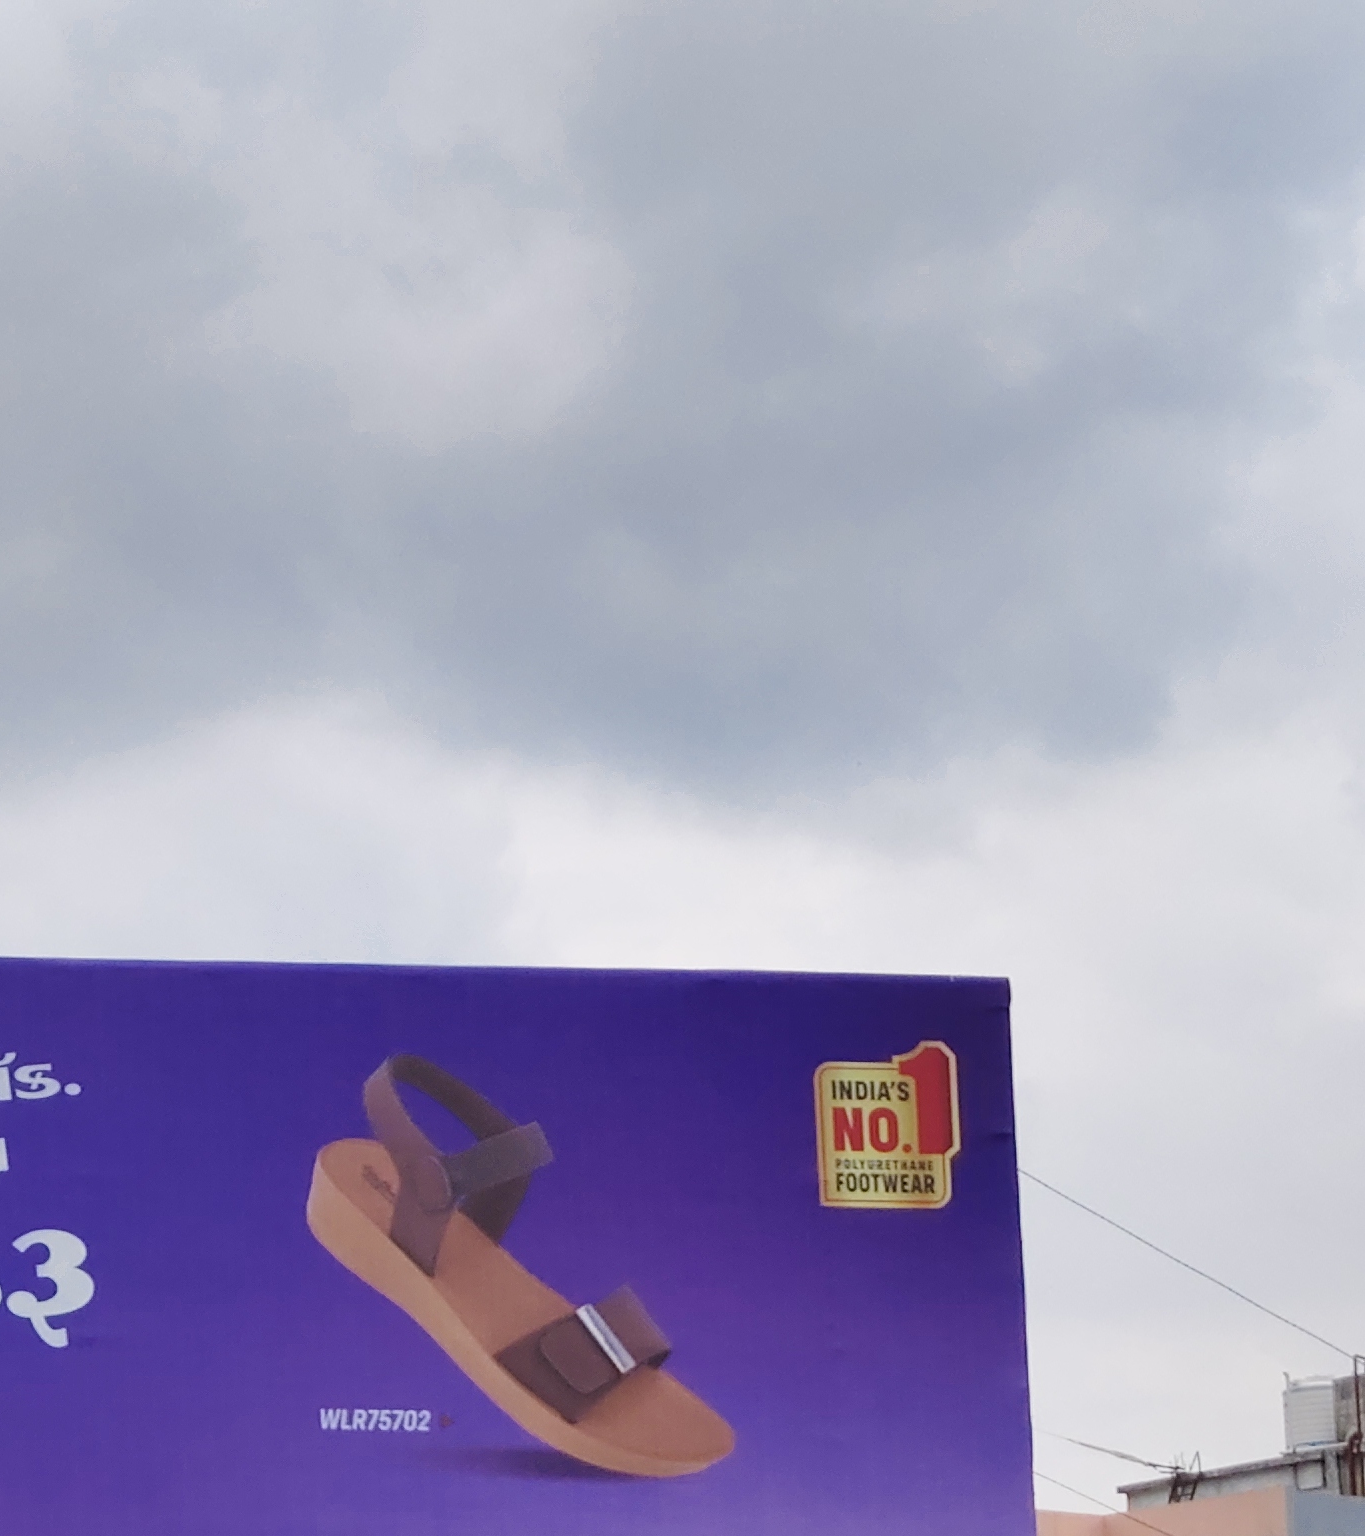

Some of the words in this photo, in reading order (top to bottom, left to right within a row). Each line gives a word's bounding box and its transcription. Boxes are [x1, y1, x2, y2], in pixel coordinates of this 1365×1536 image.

[831, 1080, 910, 1102] INDIA'S
[836, 1172, 936, 1194] FOOTWEAR
[320, 1408, 432, 1432] WLR75702
